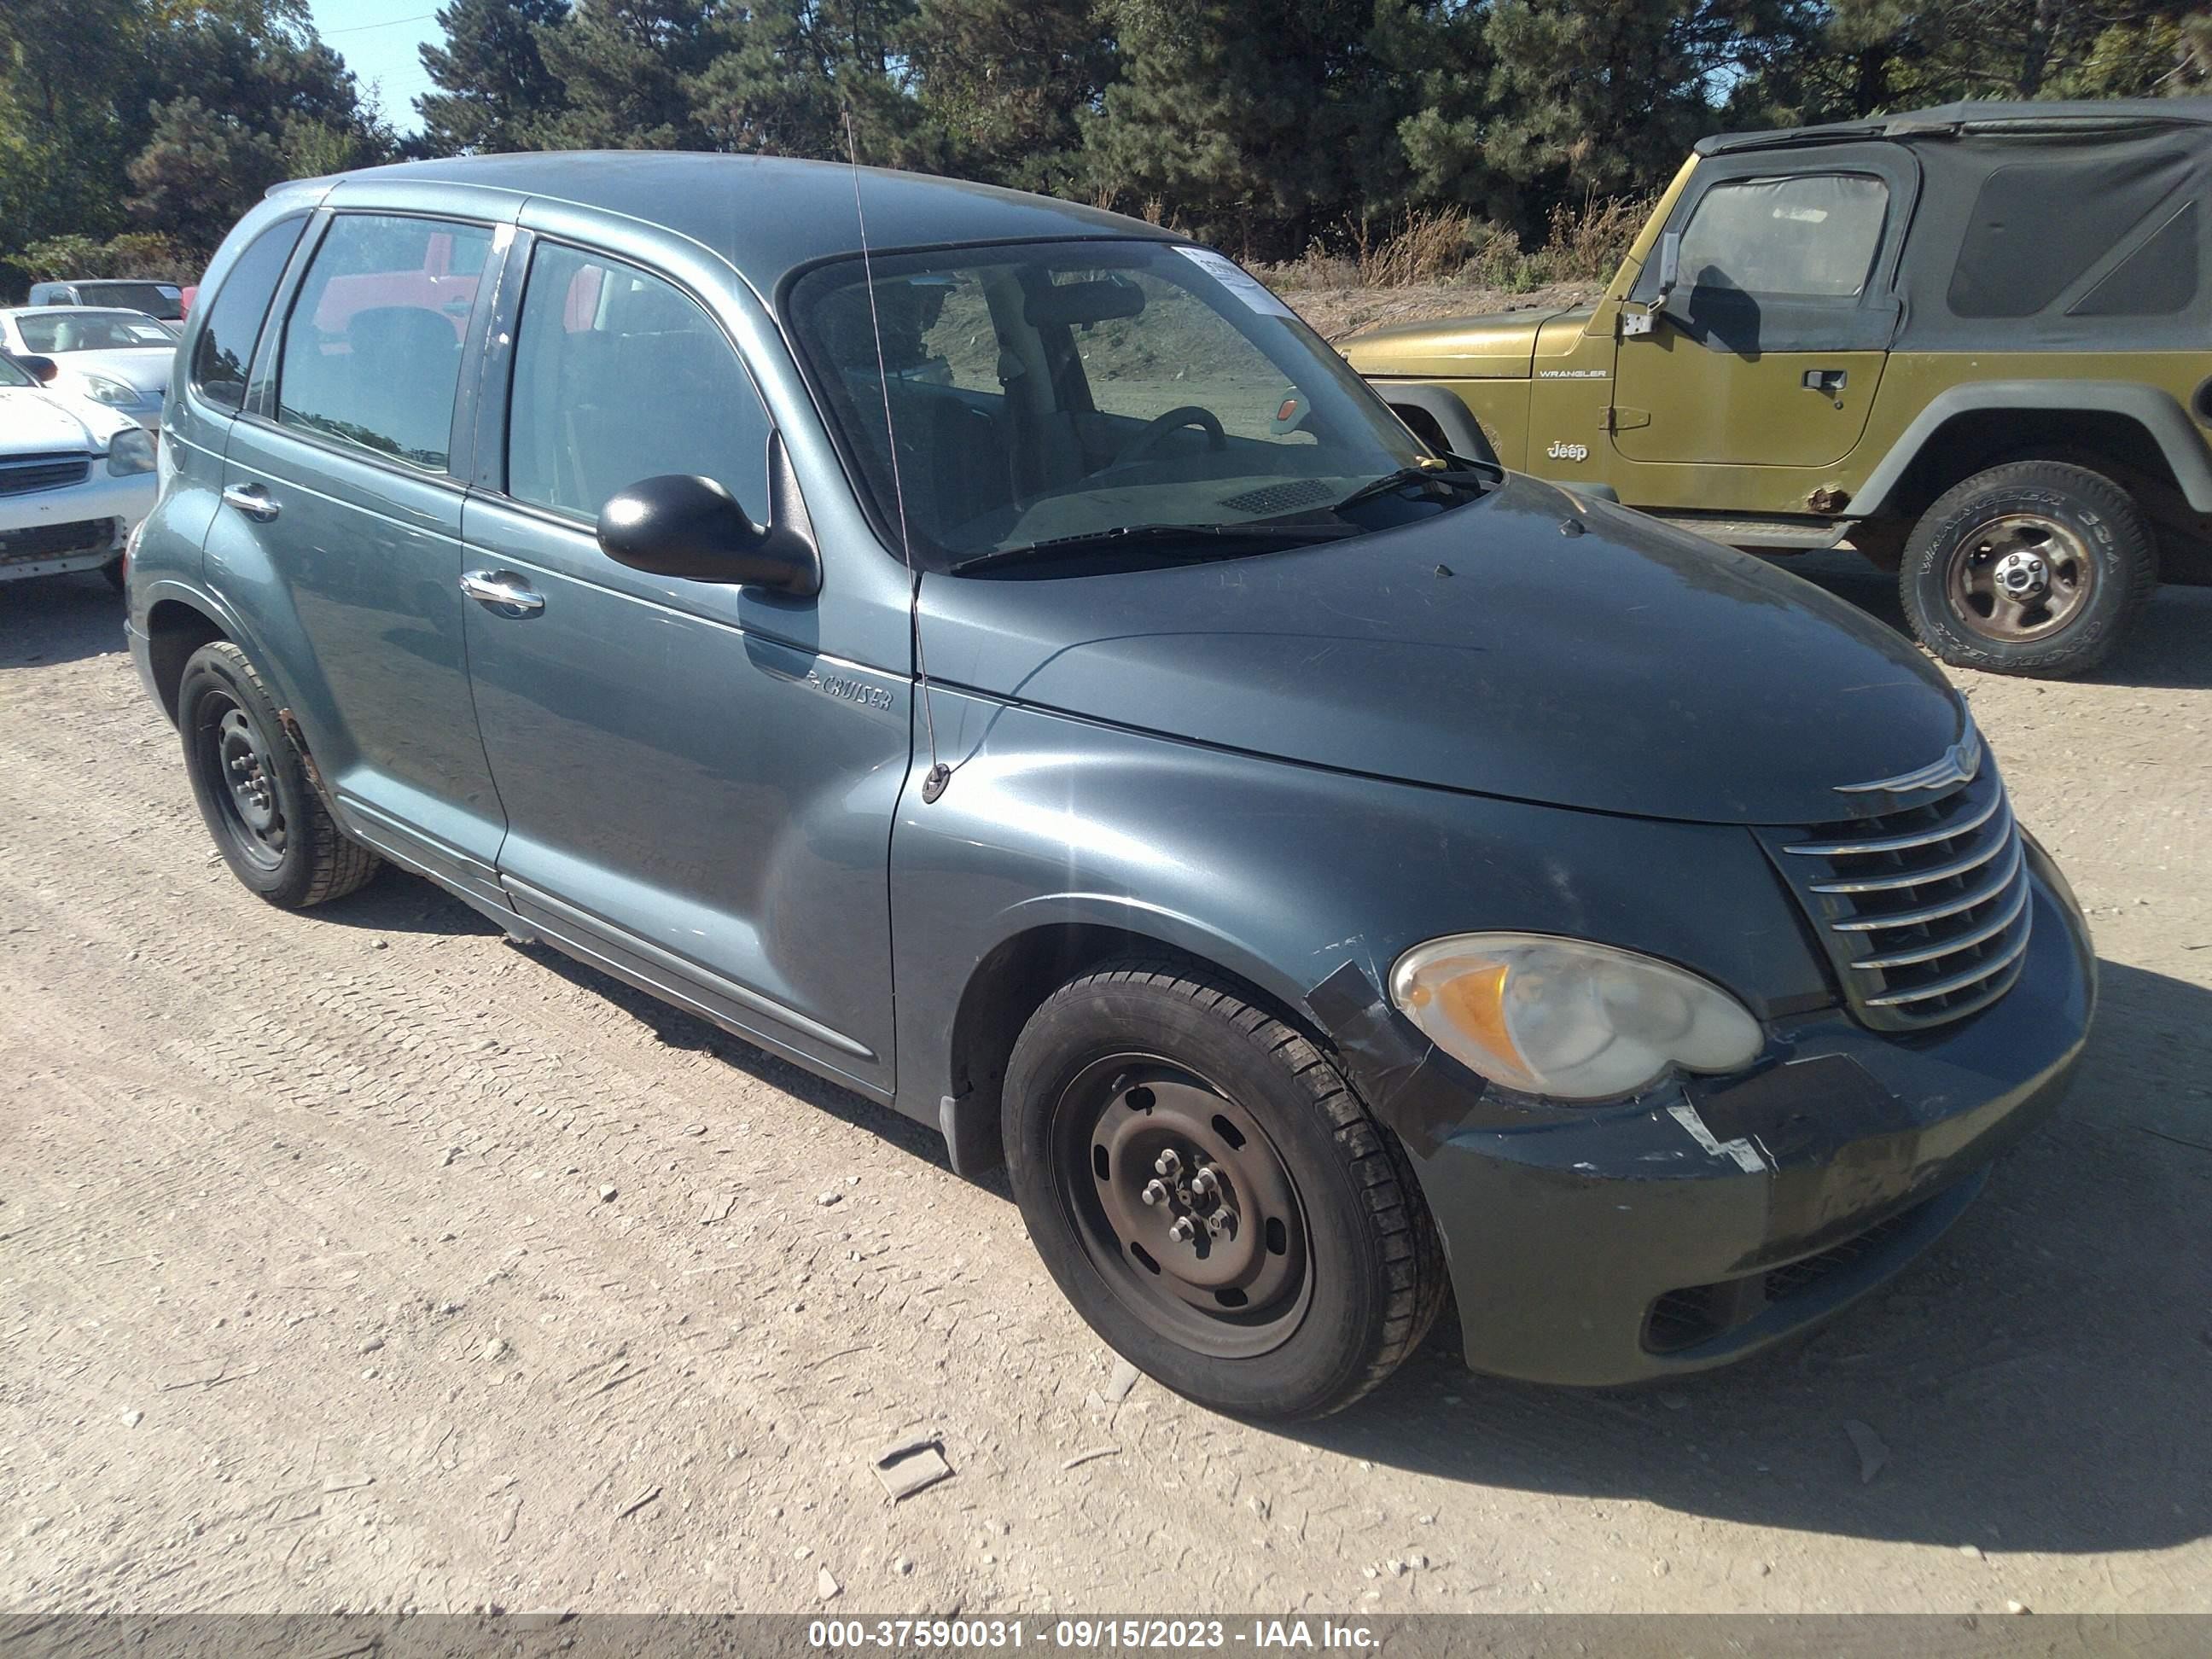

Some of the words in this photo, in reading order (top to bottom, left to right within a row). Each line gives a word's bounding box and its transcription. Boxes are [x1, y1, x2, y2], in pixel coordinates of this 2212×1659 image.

[1547, 440, 1588, 463] Jeep
[1919, 490, 2066, 576] WRANGLER
[823, 676, 894, 711] CRUISER
